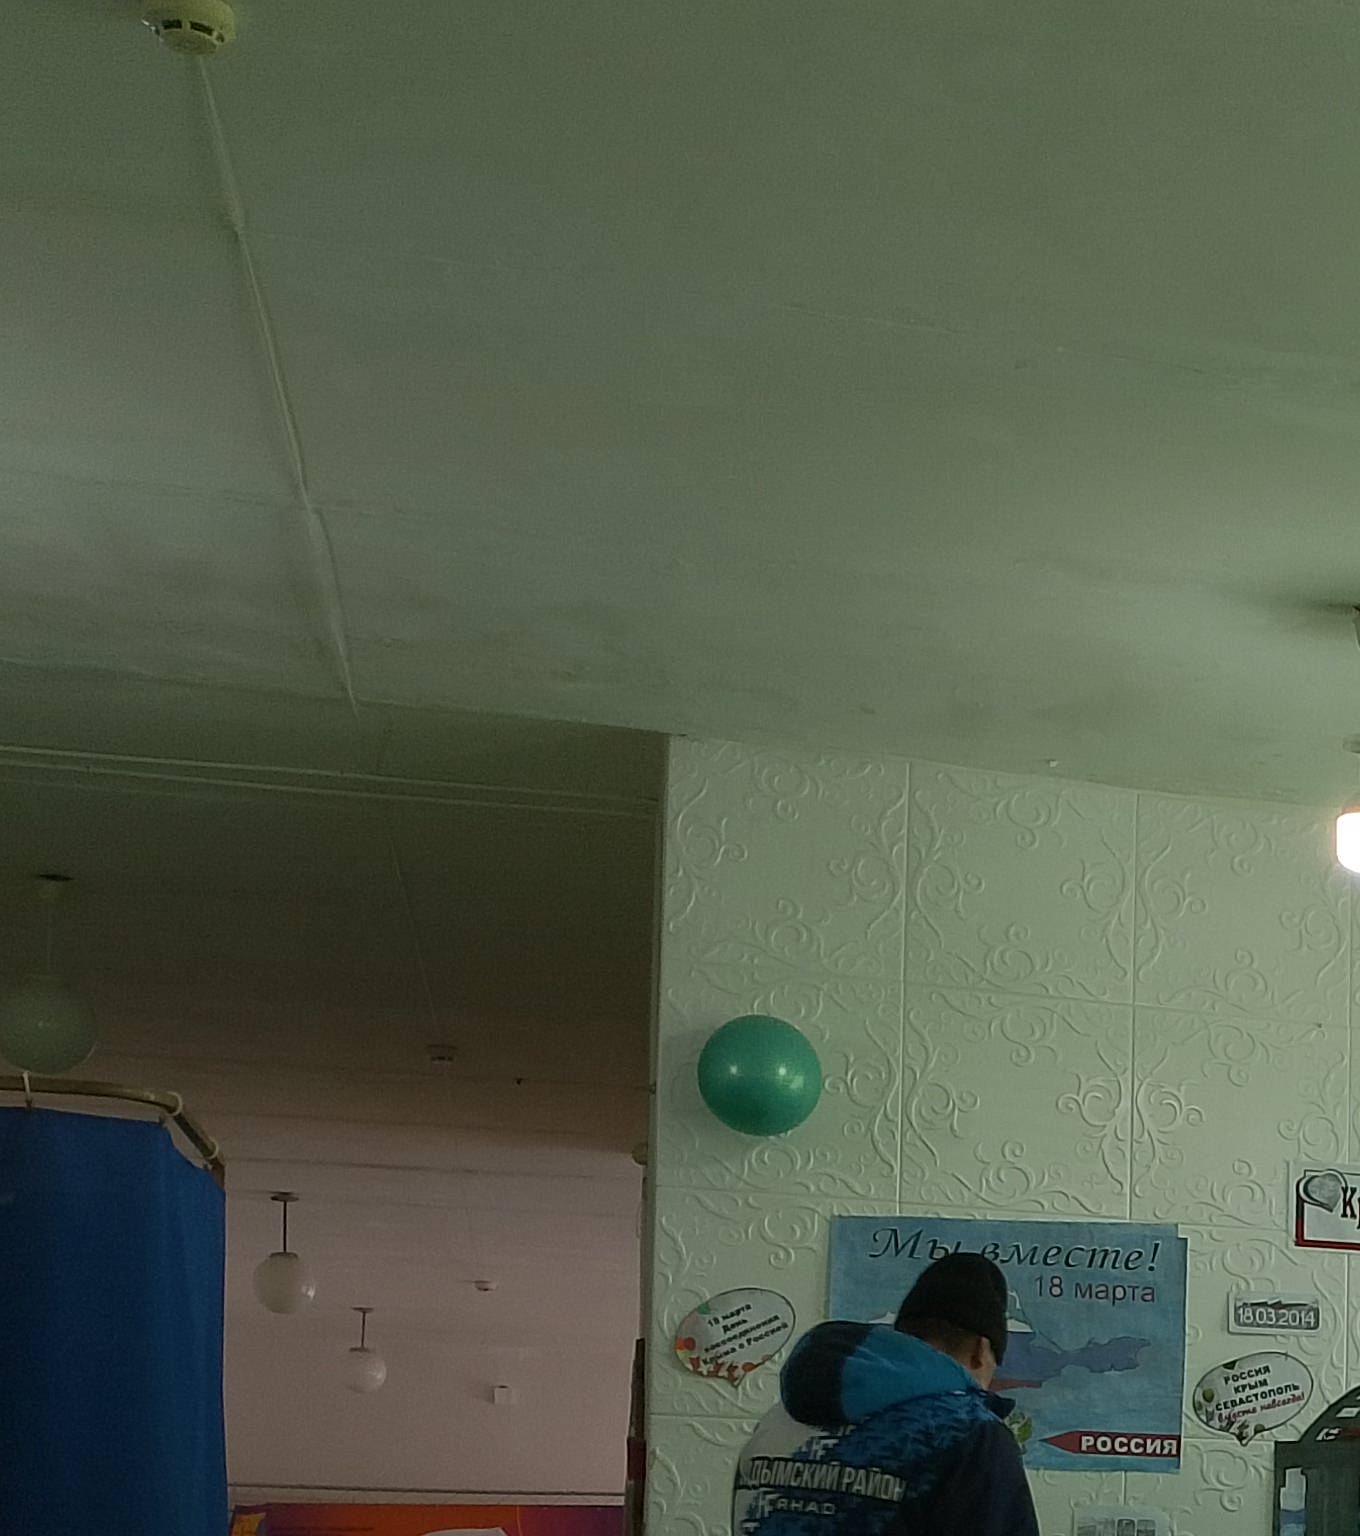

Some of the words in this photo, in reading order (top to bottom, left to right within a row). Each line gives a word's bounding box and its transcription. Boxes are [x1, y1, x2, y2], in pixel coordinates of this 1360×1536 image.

[981, 1241, 1161, 1272] вместе!
[1034, 1275, 1064, 1298] 18
[1074, 1282, 1156, 1305] марта
[708, 1317, 720, 1327] 18
[1237, 1306, 1316, 1328] 18.03.2014
[1223, 1365, 1271, 1385] РОССИЯ
[1233, 1378, 1268, 1394] КРЫМ
[1215, 1383, 1300, 1411] СЕВАСТОПОЛЬ
[1080, 1434, 1178, 1456] РОССИЯ
[740, 1459, 841, 1491] ДЫМСКИЙ
[842, 1467, 907, 1502] РАЙОН
